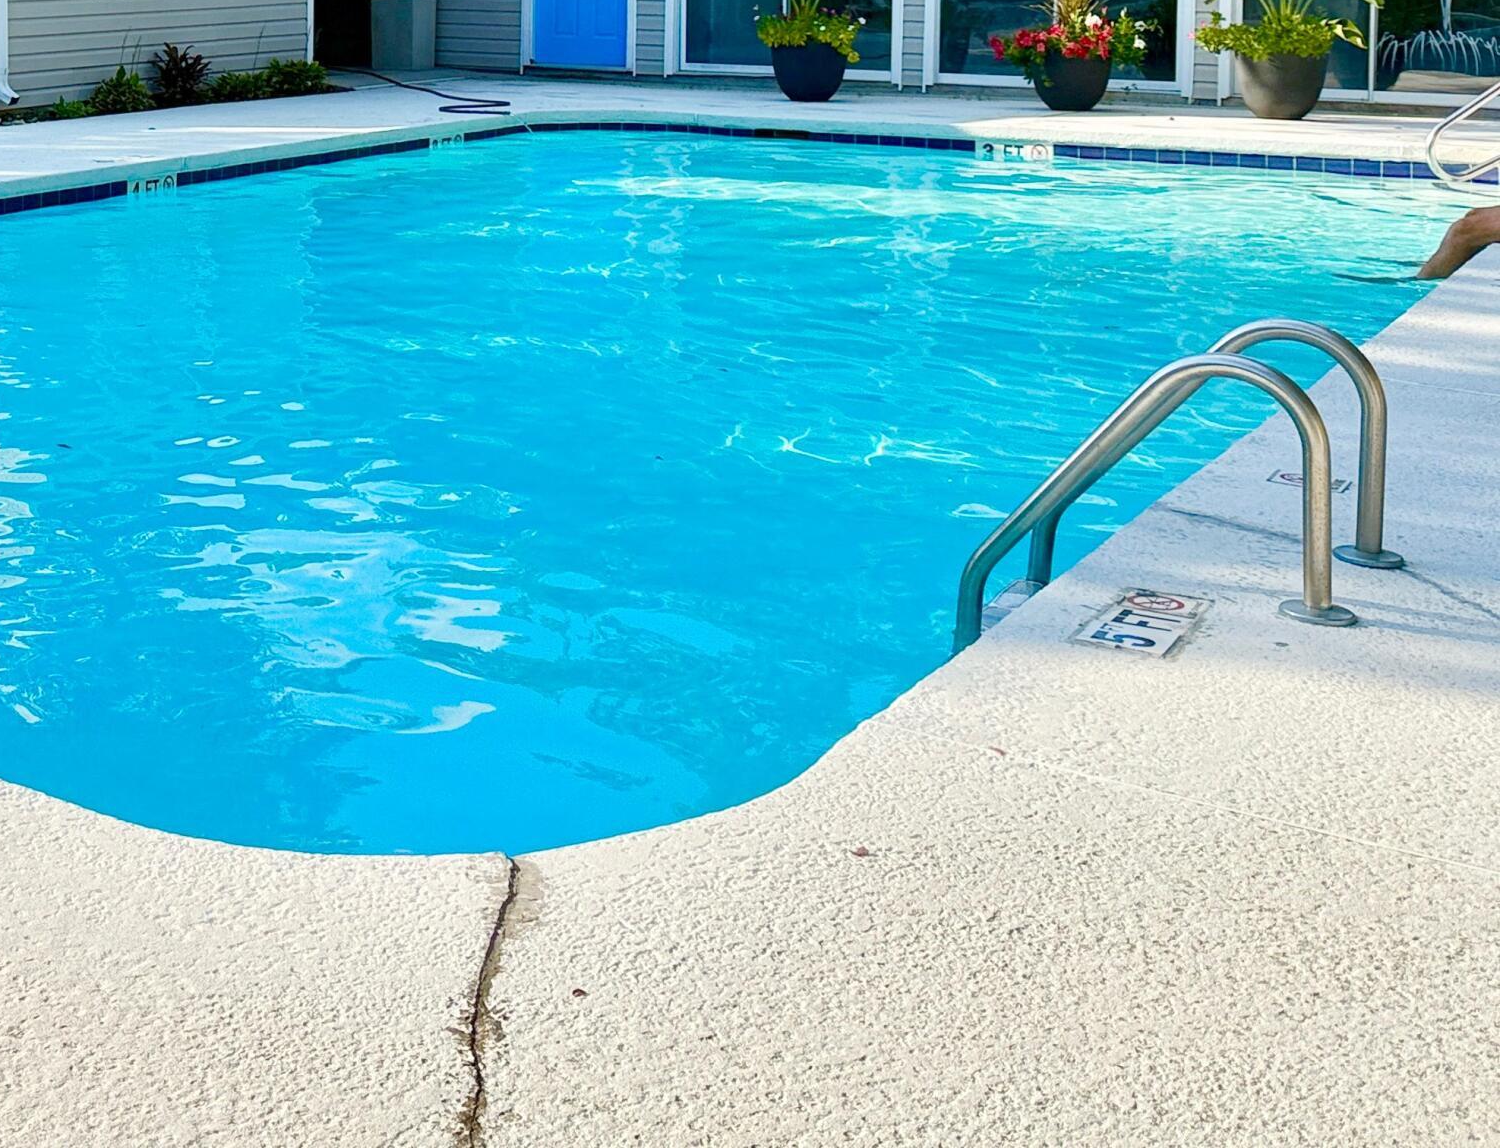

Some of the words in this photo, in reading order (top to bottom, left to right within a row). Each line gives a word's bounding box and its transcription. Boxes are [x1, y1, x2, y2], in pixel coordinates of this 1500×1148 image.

[1004, 145, 1024, 156] FT
[1111, 609, 1181, 632] FT
[1091, 623, 1156, 647] 5
